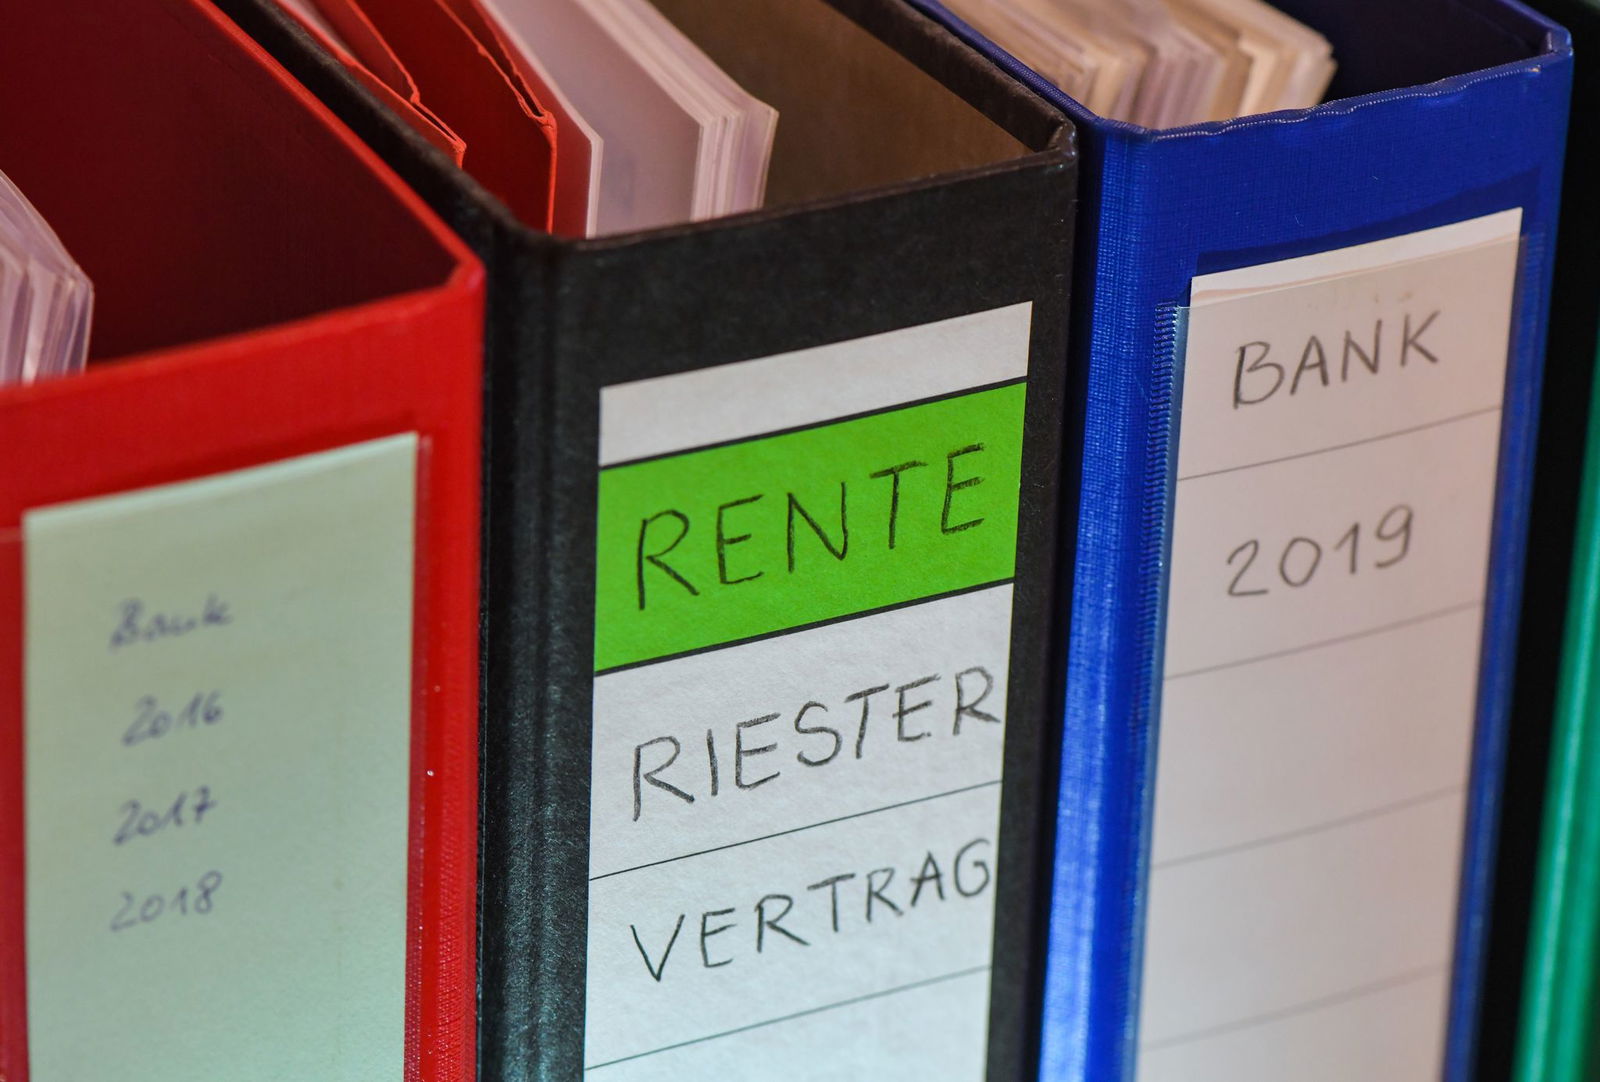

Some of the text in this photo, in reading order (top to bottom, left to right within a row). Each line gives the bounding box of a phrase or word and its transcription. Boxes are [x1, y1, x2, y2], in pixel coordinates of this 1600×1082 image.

[1233, 310, 1441, 410] BANK
[637, 442, 985, 610] RENTE
[1226, 504, 1414, 596] 2019
[110, 594, 233, 650] Bank
[122, 690, 225, 747] 2016
[633, 666, 1001, 822] RIESTER
[113, 786, 218, 846] 2017
[110, 870, 223, 932] 2018
[631, 837, 991, 982] VERTRAG
